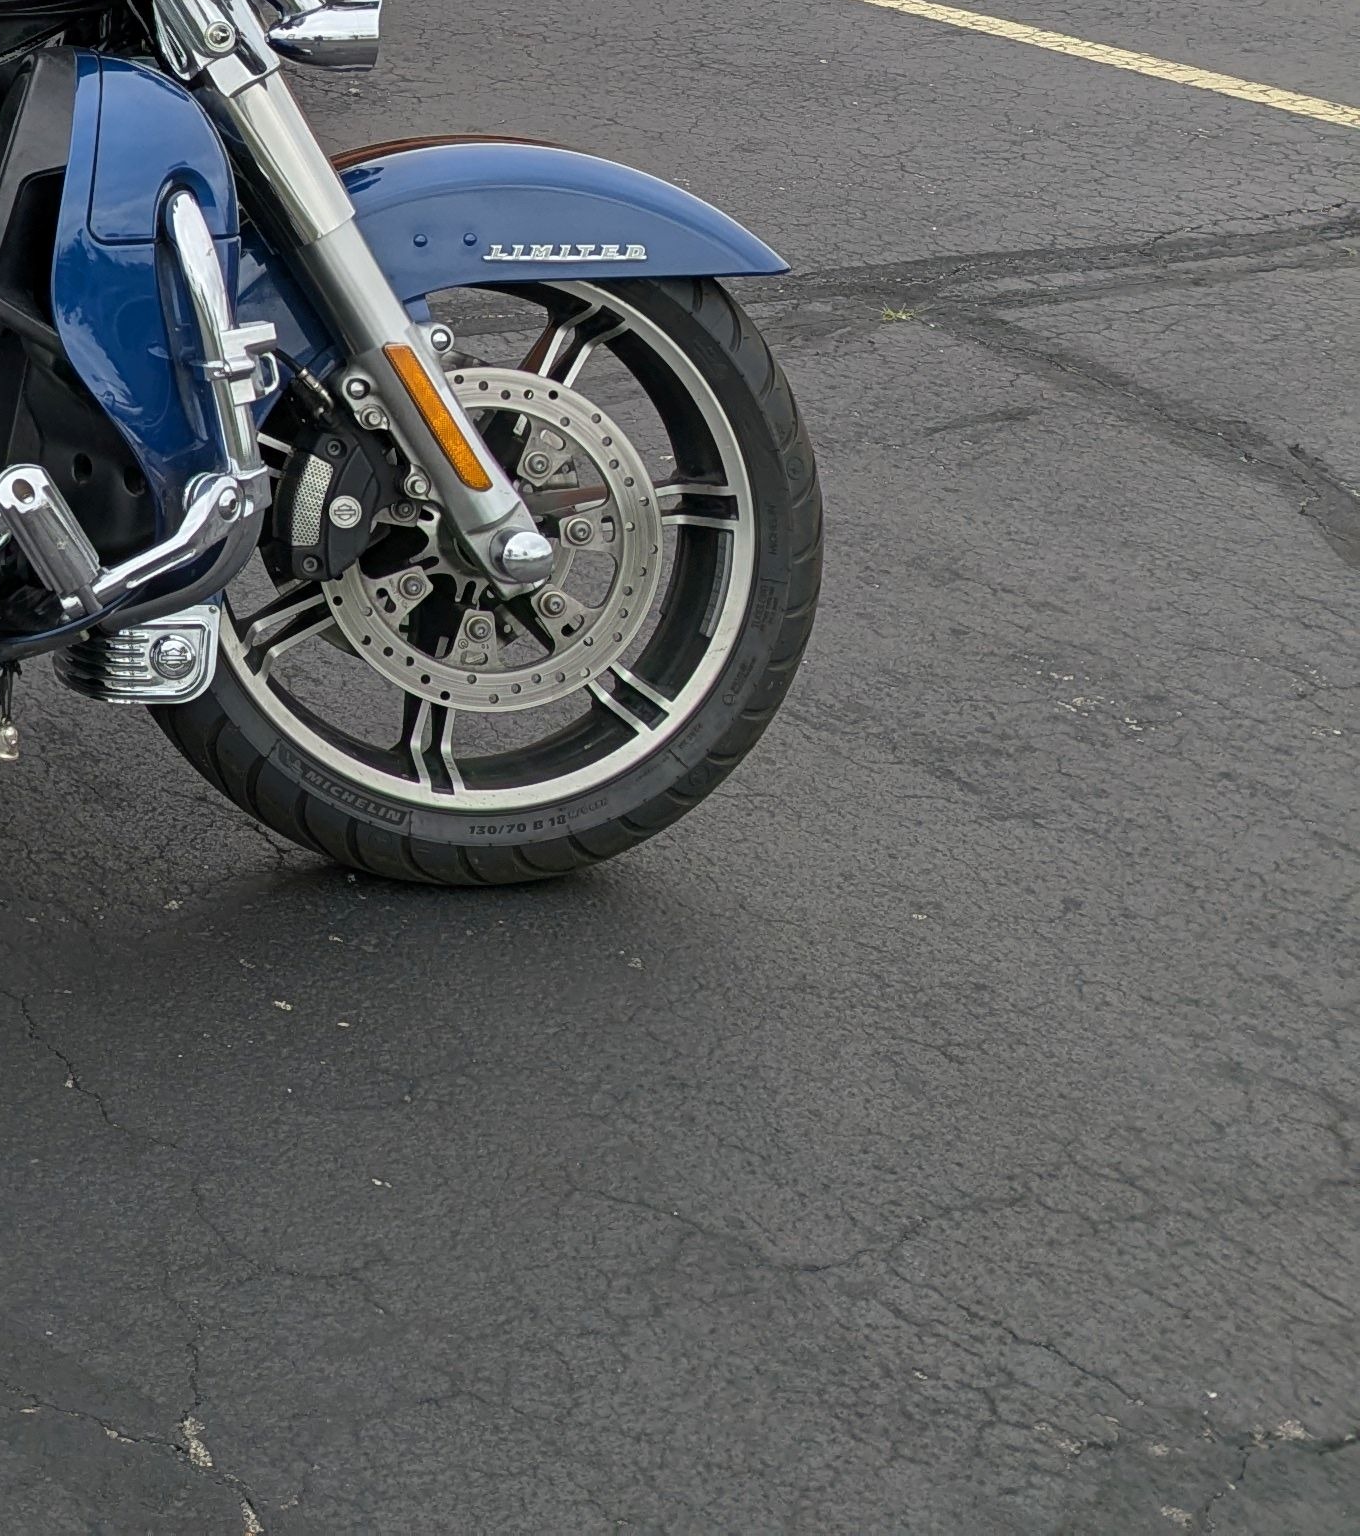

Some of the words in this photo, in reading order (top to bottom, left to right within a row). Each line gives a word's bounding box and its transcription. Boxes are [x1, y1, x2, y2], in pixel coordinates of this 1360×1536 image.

[487, 244, 647, 261] LIMITED
[304, 770, 401, 822] MICHELIN
[468, 822, 527, 836] 130/70
